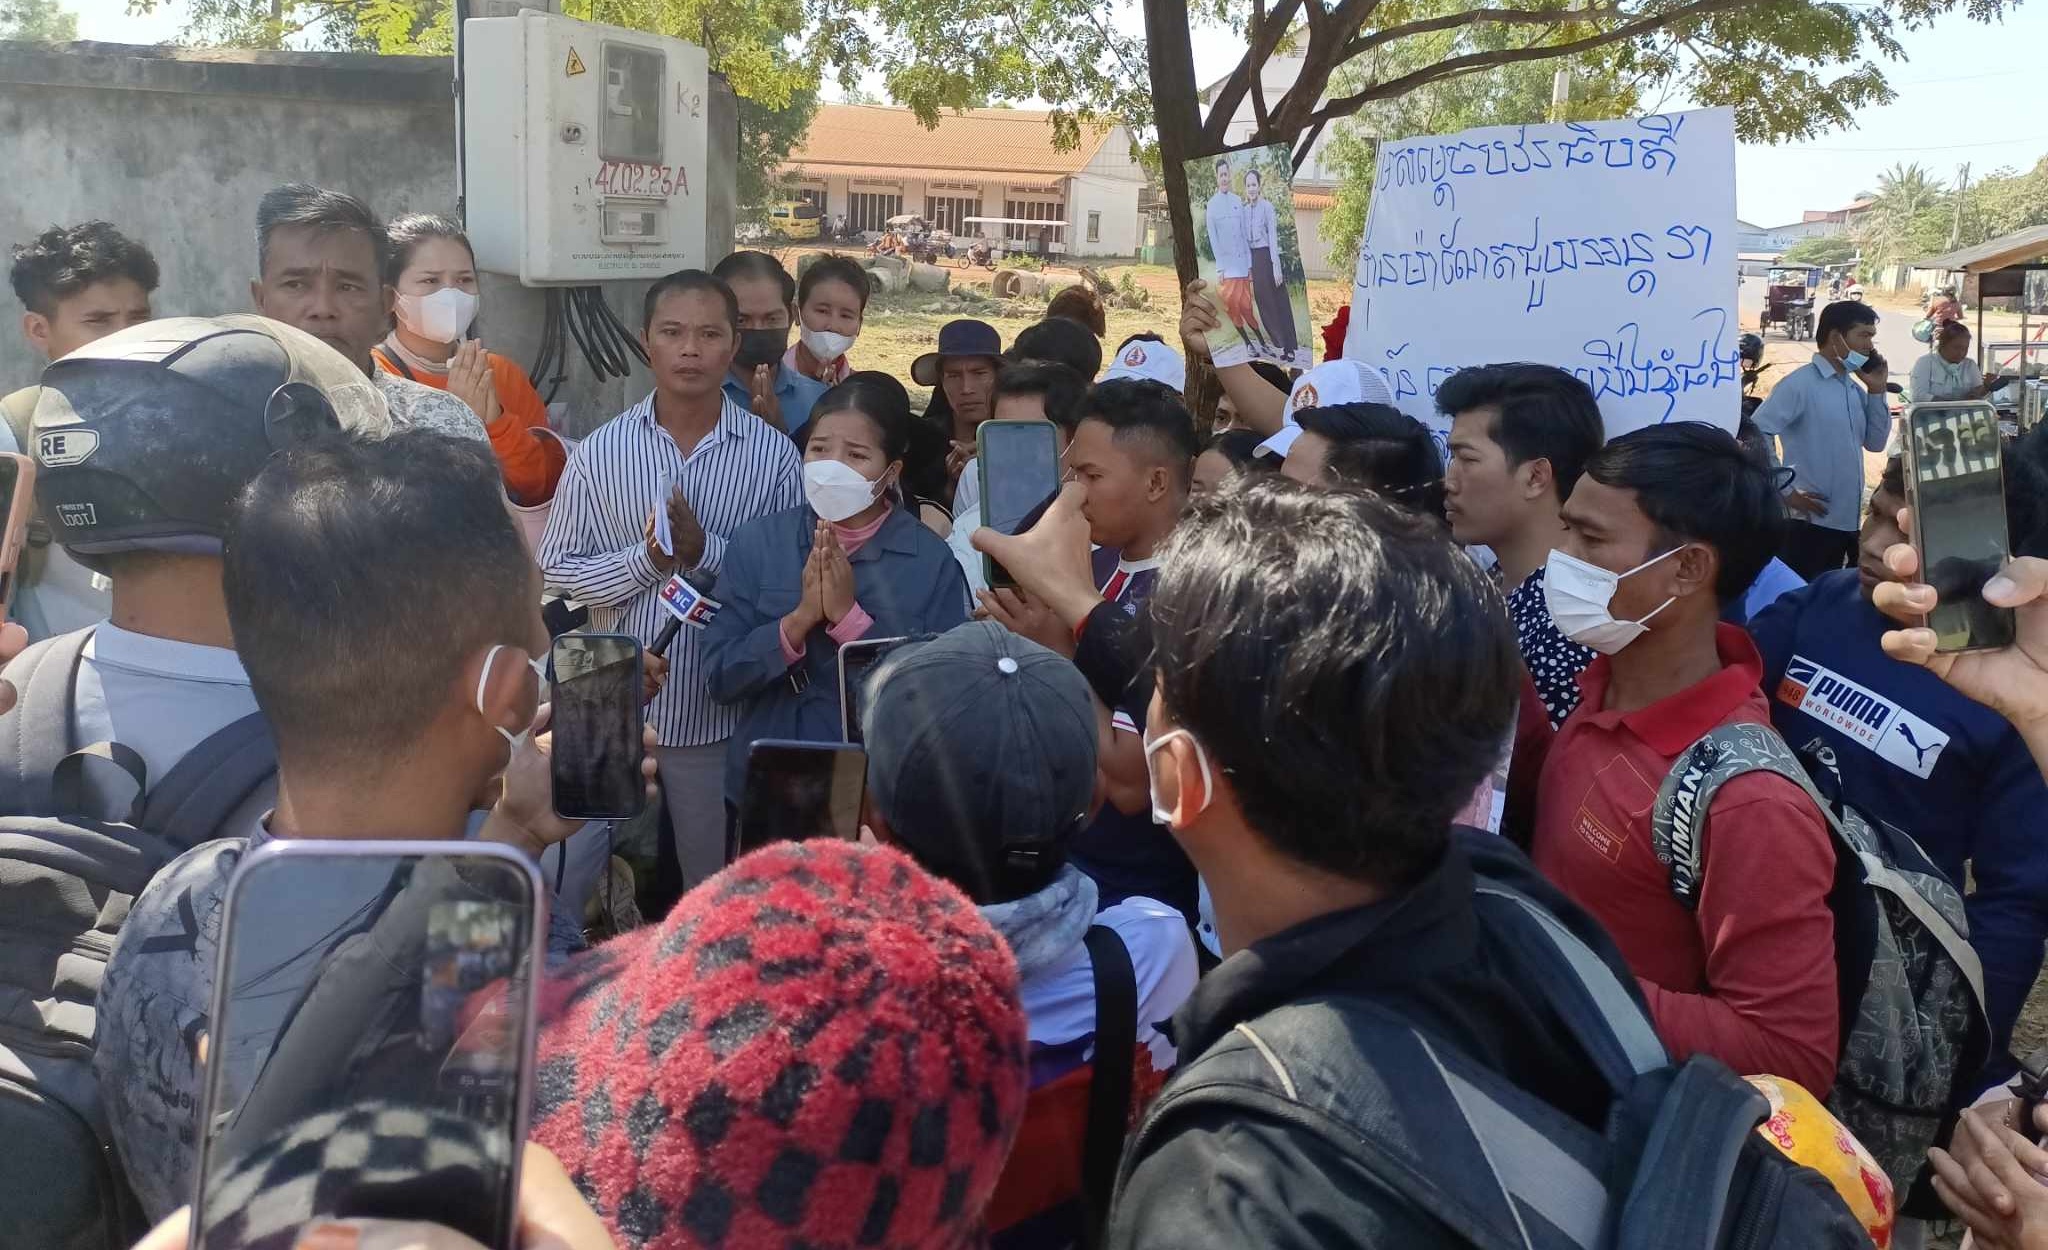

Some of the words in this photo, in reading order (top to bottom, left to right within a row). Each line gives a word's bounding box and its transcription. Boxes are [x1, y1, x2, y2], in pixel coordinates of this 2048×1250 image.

[1805, 699, 1876, 742] WORLDWIDE
[1811, 675, 1891, 730] PUMA
[1582, 816, 1611, 847] WELCOME
